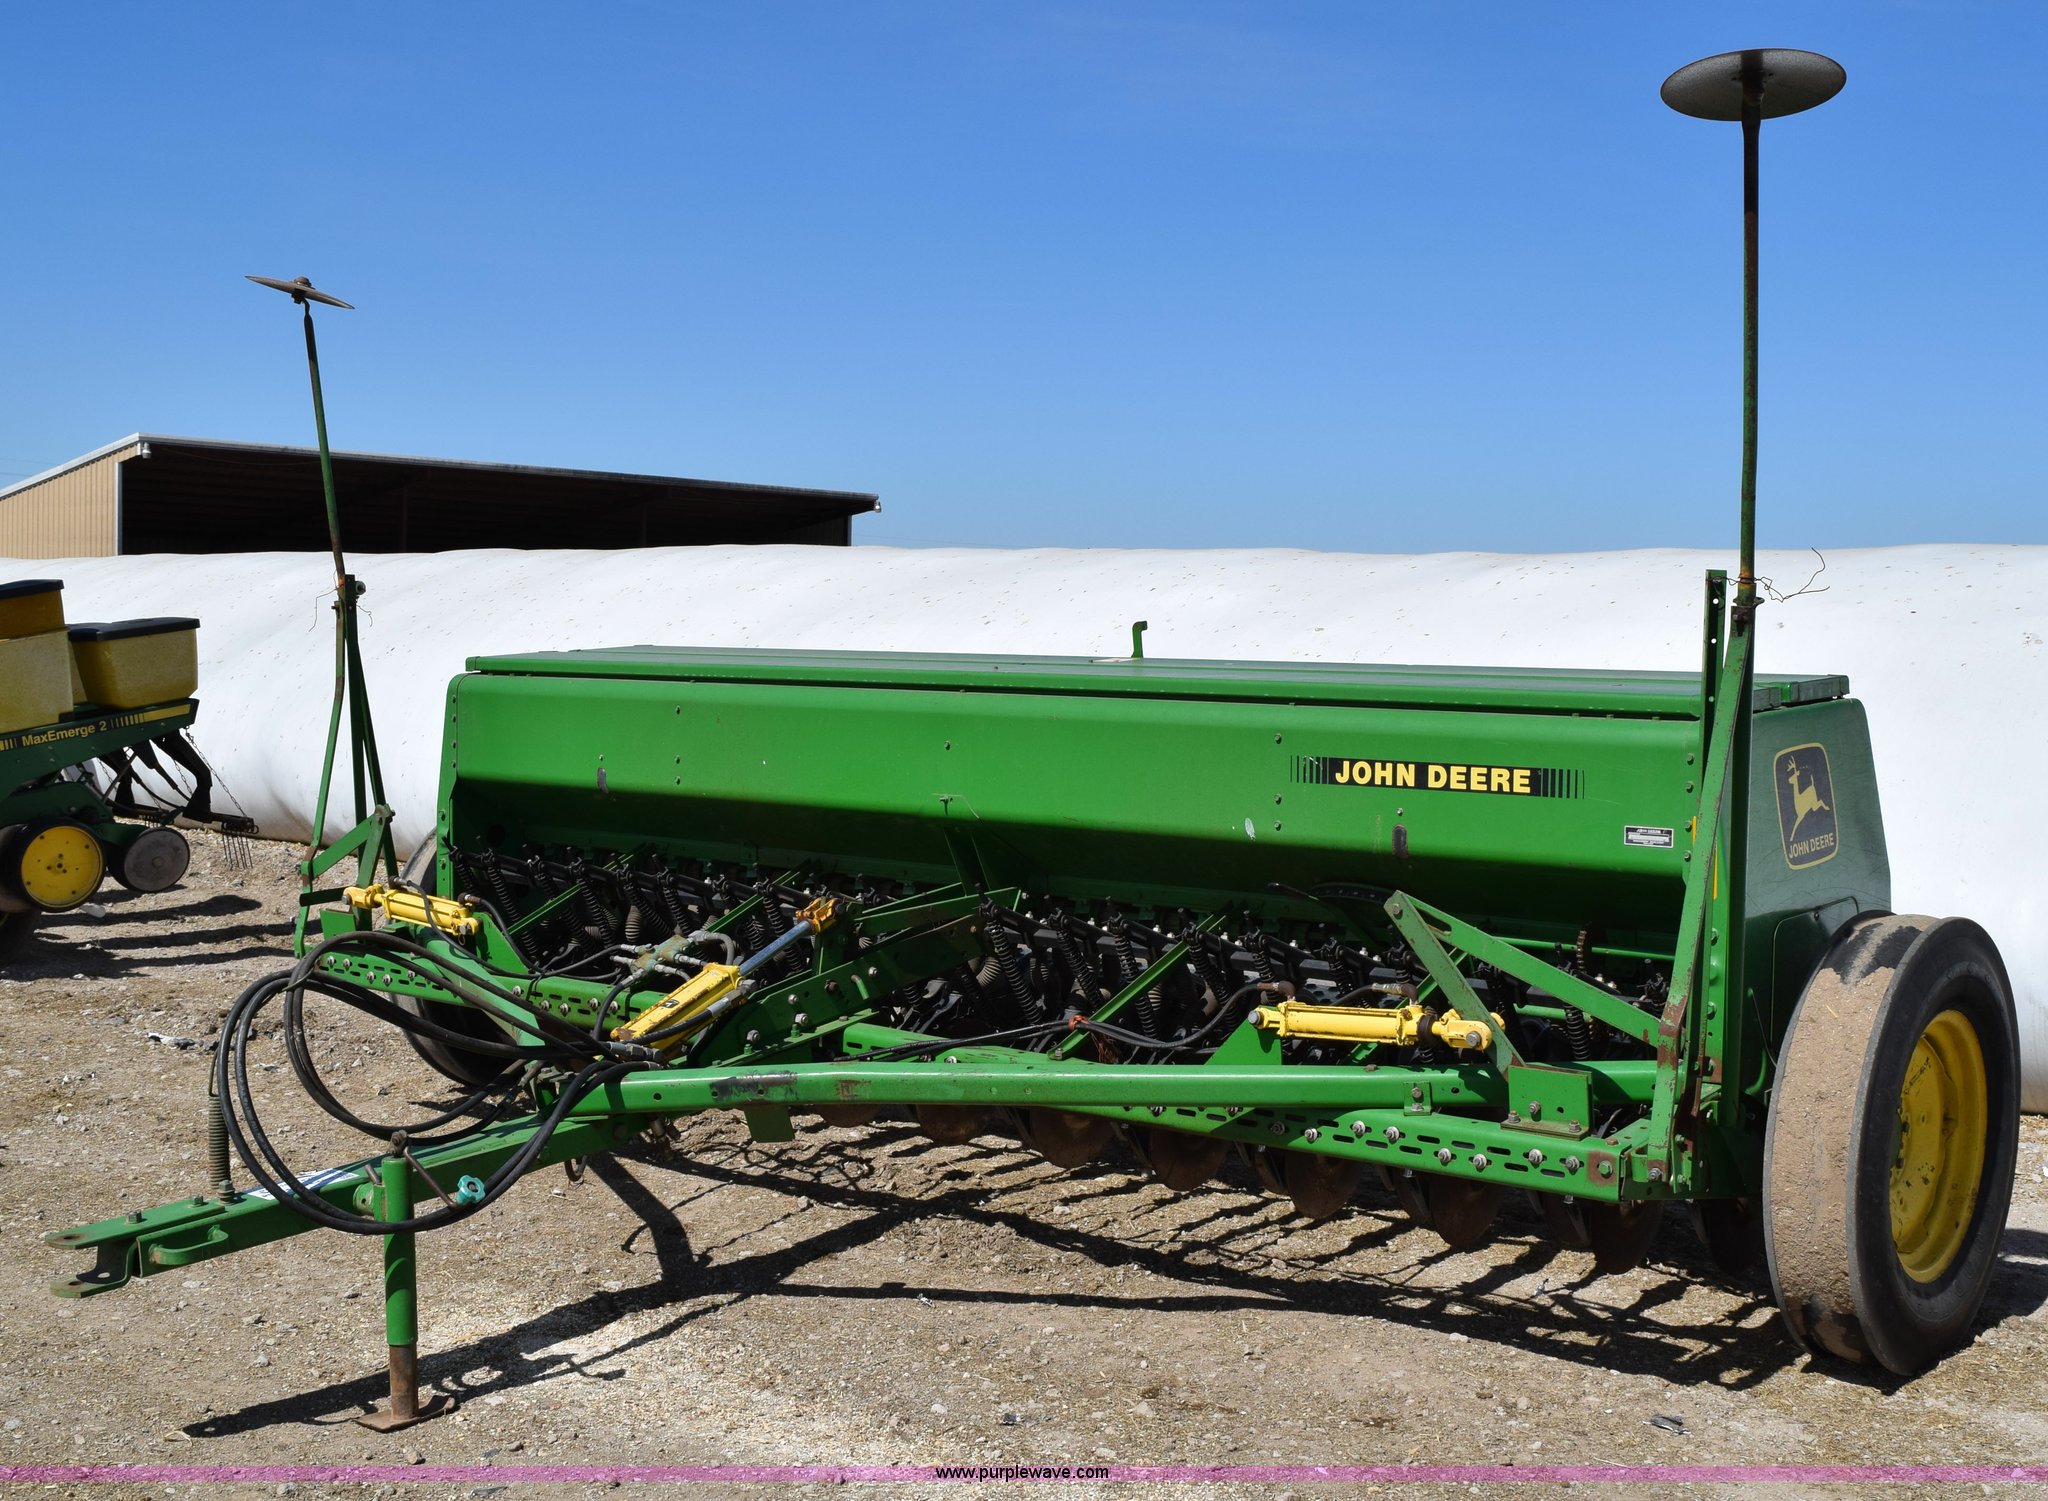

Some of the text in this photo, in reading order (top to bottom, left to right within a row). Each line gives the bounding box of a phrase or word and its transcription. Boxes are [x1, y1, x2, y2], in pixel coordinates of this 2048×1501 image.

[21, 720, 108, 747] MaxEmerge 2
[1334, 760, 1531, 794] JOHN DEERE
[1788, 832, 1835, 859] JOHN DEERE
